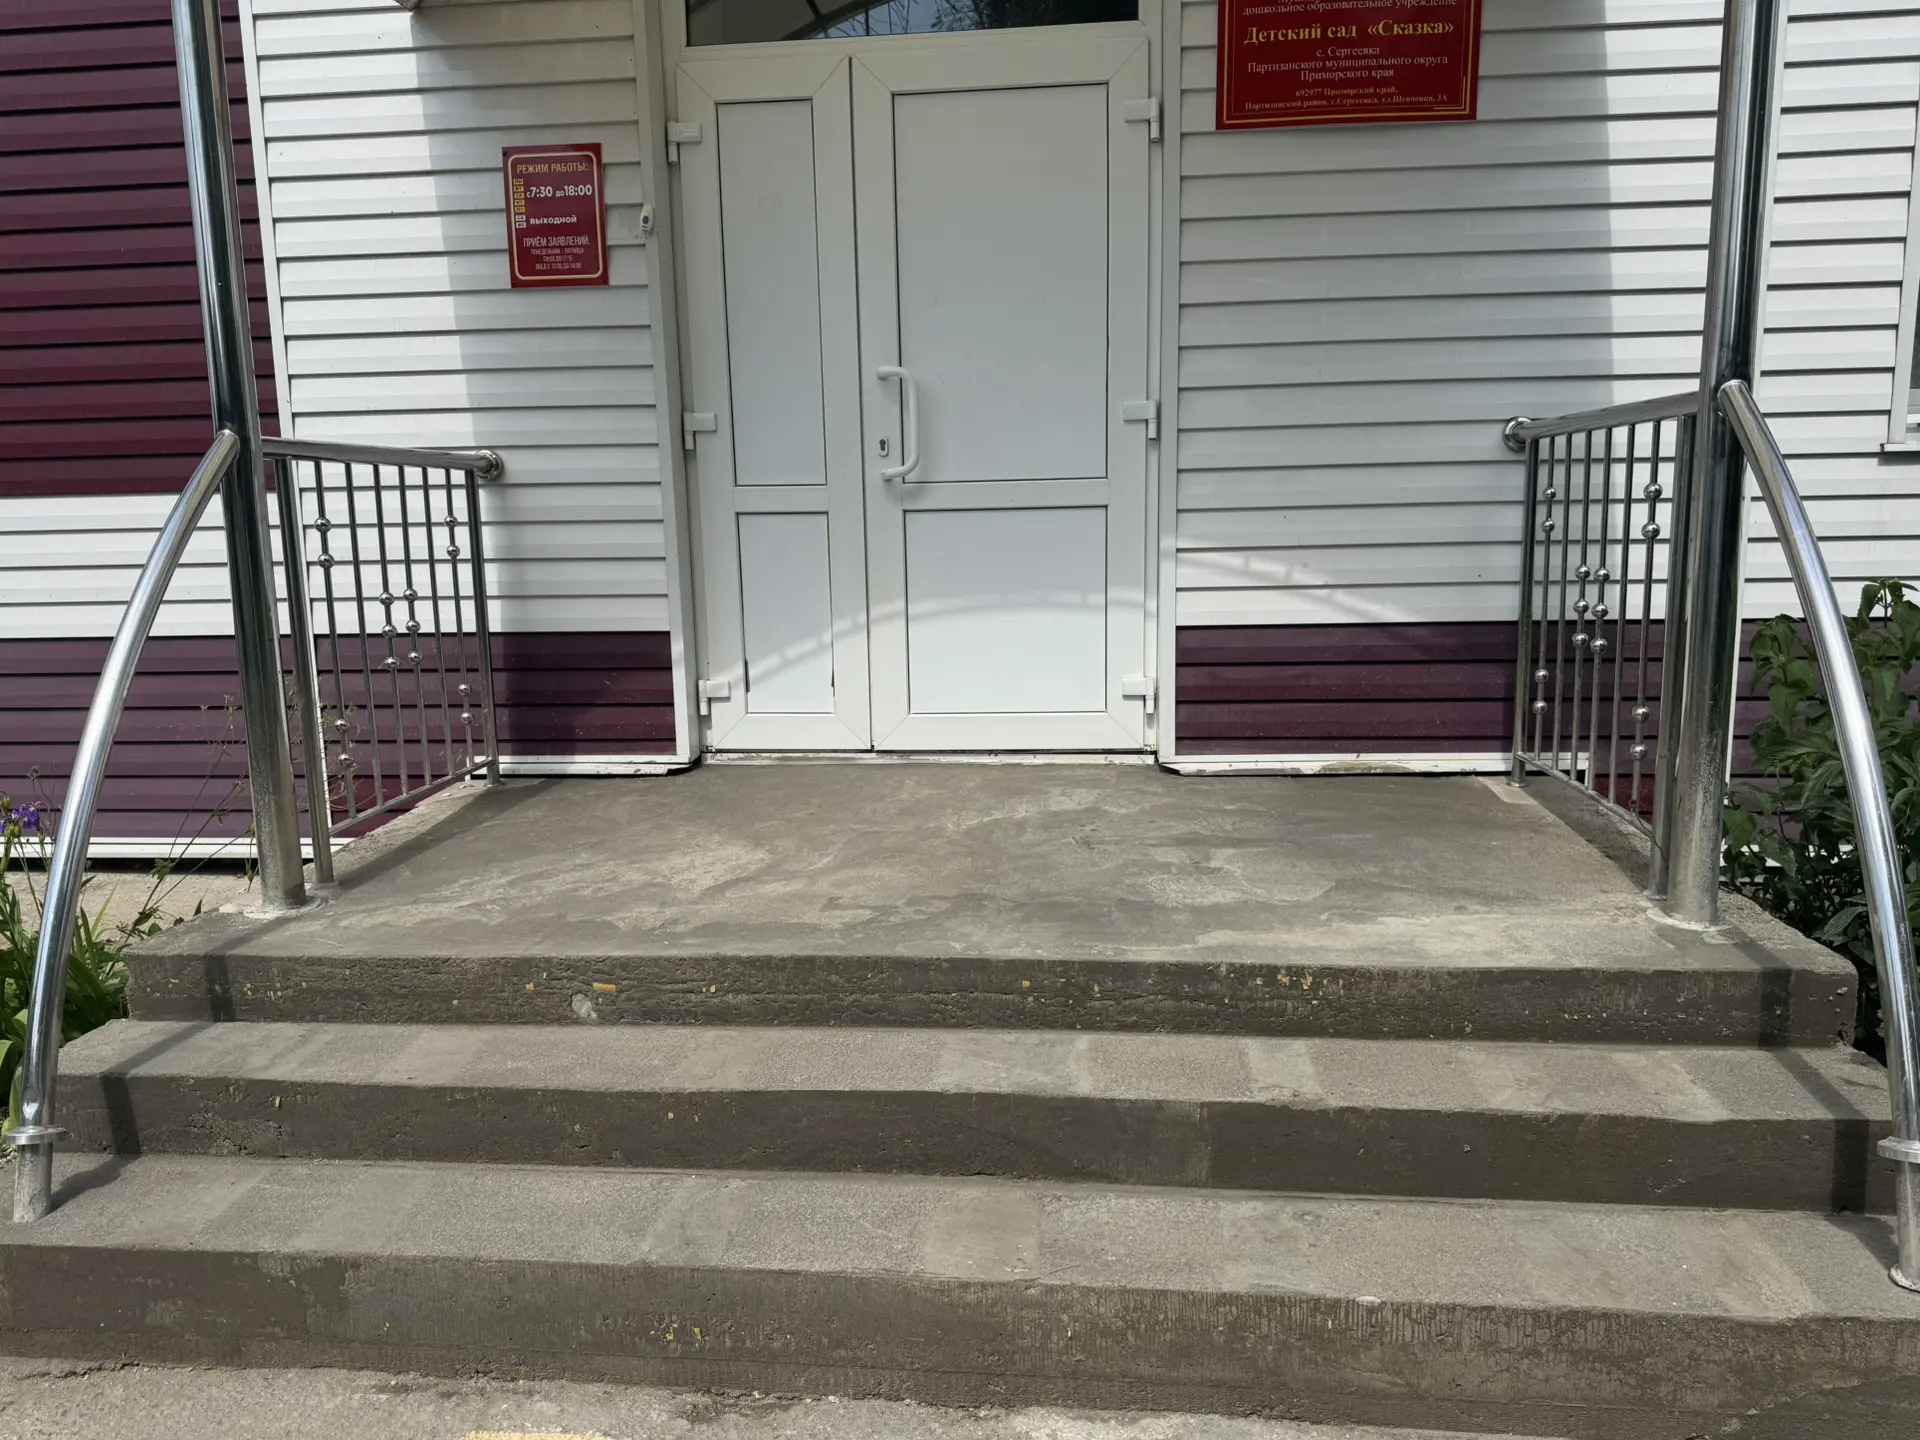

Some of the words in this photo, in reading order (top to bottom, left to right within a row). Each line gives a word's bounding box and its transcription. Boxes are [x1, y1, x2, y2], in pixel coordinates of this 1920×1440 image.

[1242, 4, 1305, 16] дошкольное
[1307, 0, 1393, 12] образовательное
[1243, 23, 1321, 46] Детский
[1327, 25, 1357, 40] сад
[1367, 19, 1454, 36] «Сказка»
[1327, 46, 1380, 59] Сергеевка
[1247, 60, 1323, 75] Партизанского
[1325, 56, 1412, 71] муниципального
[1413, 55, 1448, 67] округа
[1300, 69, 1369, 83] Приморского
[1371, 67, 1394, 80] края
[517, 163, 549, 174] РЕЖИМ
[551, 161, 589, 173] РАБОТЫ:
[530, 214, 577, 225] выходной
[523, 236, 547, 248] ПРИЁМ
